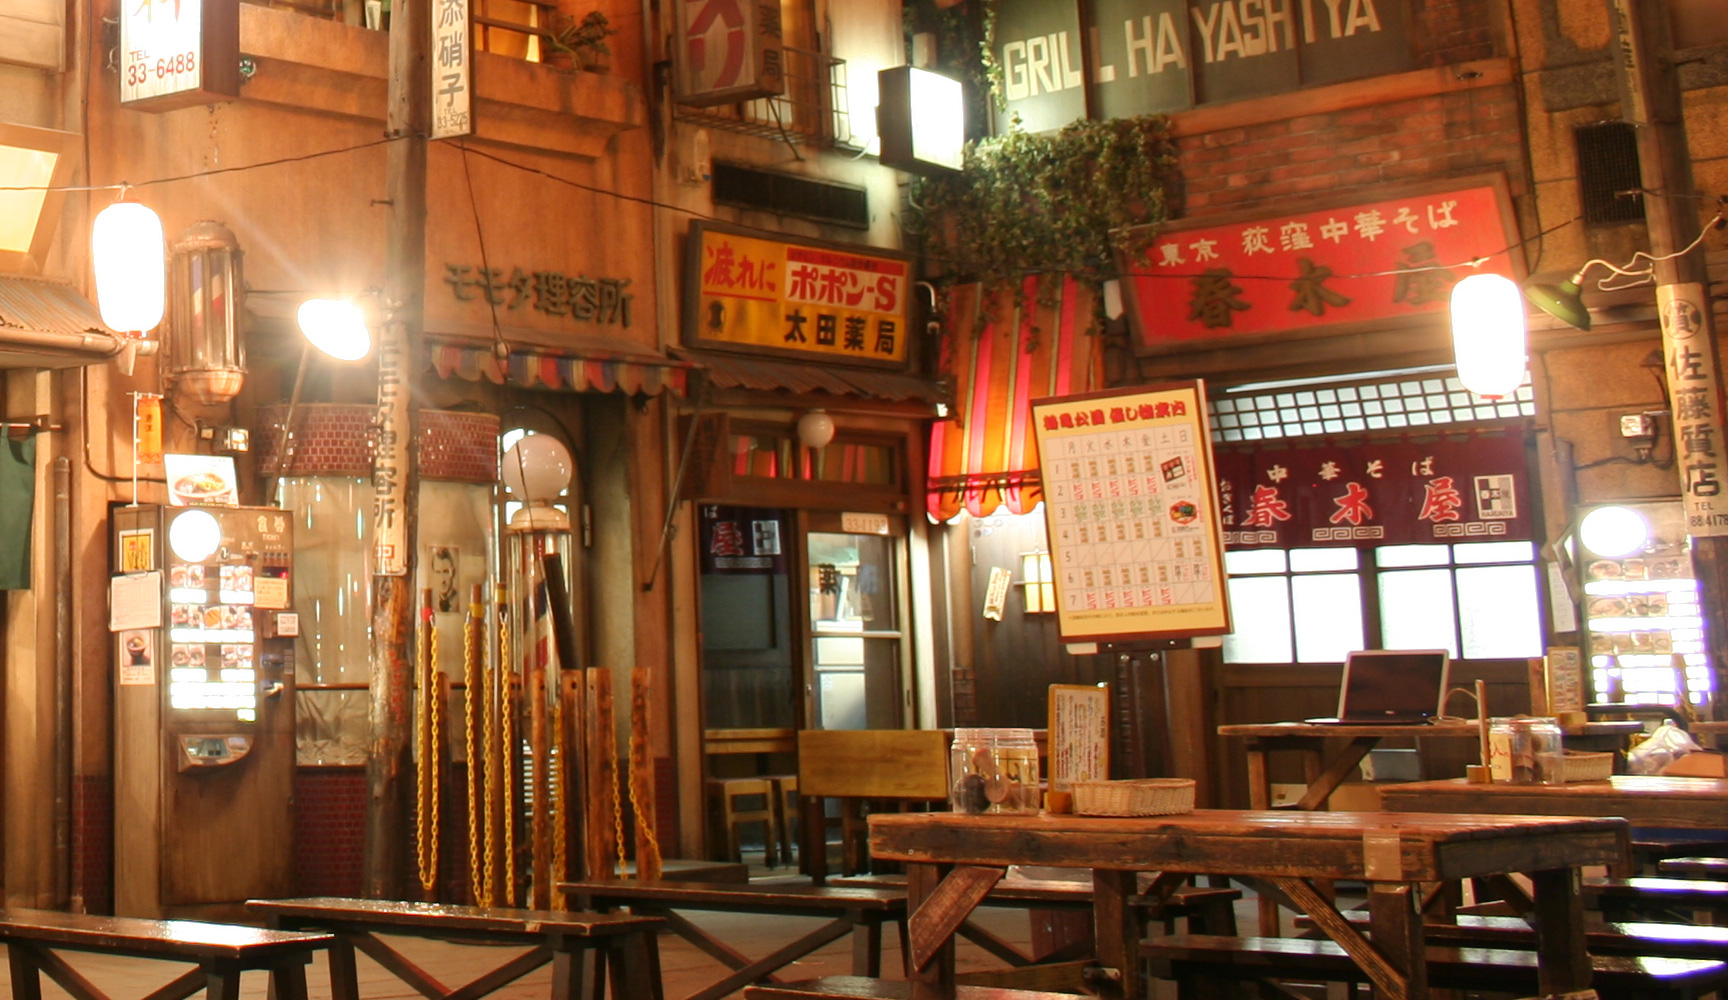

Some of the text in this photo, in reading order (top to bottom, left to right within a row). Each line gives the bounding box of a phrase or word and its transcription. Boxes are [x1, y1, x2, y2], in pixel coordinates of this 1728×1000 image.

[128, 51, 195, 87] 33-6488
[129, 49, 150, 62] TEL
[1003, 29, 1115, 102] GRILL
[1187, 240, 1458, 329] 春木屋
[784, 309, 896, 355] 太田薬局
[1670, 345, 1721, 498] 佐藤質店
[1266, 456, 1435, 484] 中華そば
[1240, 475, 1461, 528] 春木屋
[1694, 501, 1714, 511] TEL
